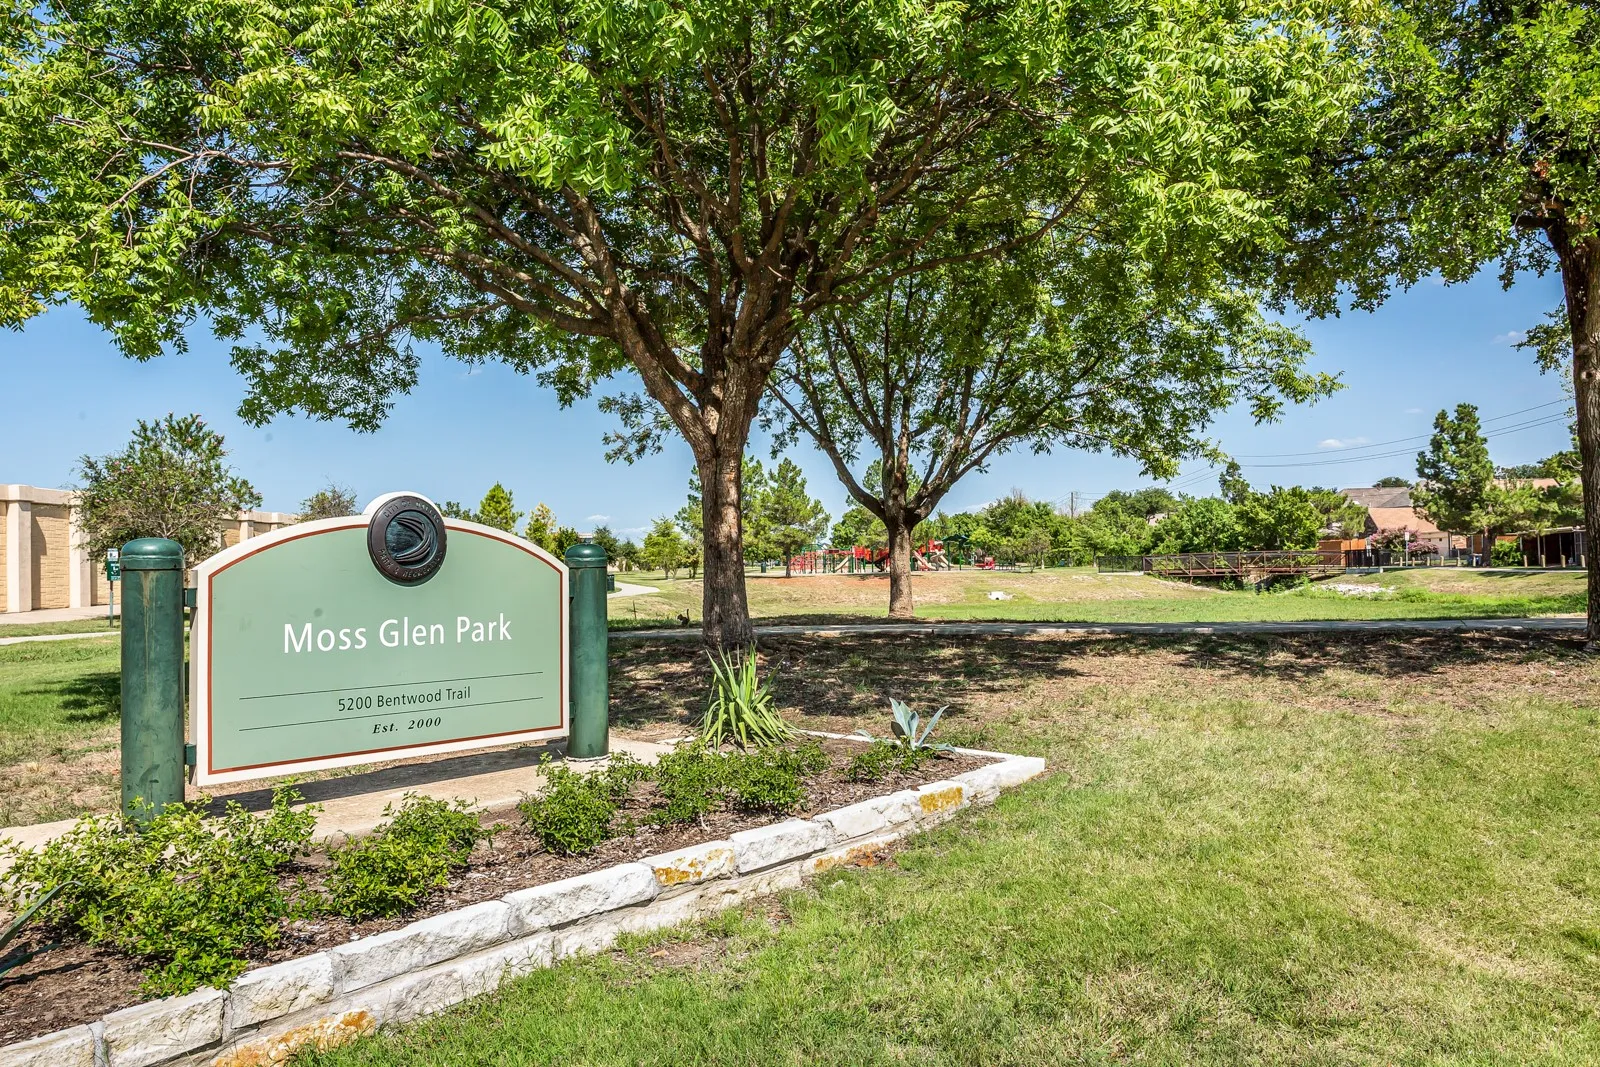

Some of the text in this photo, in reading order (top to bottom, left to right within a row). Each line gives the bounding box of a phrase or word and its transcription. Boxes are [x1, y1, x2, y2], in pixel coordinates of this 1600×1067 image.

[284, 612, 512, 653] Moss Glen Park
[338, 685, 471, 712] 5200 Bentwood Trail
[372, 716, 442, 735] Est. 2000
